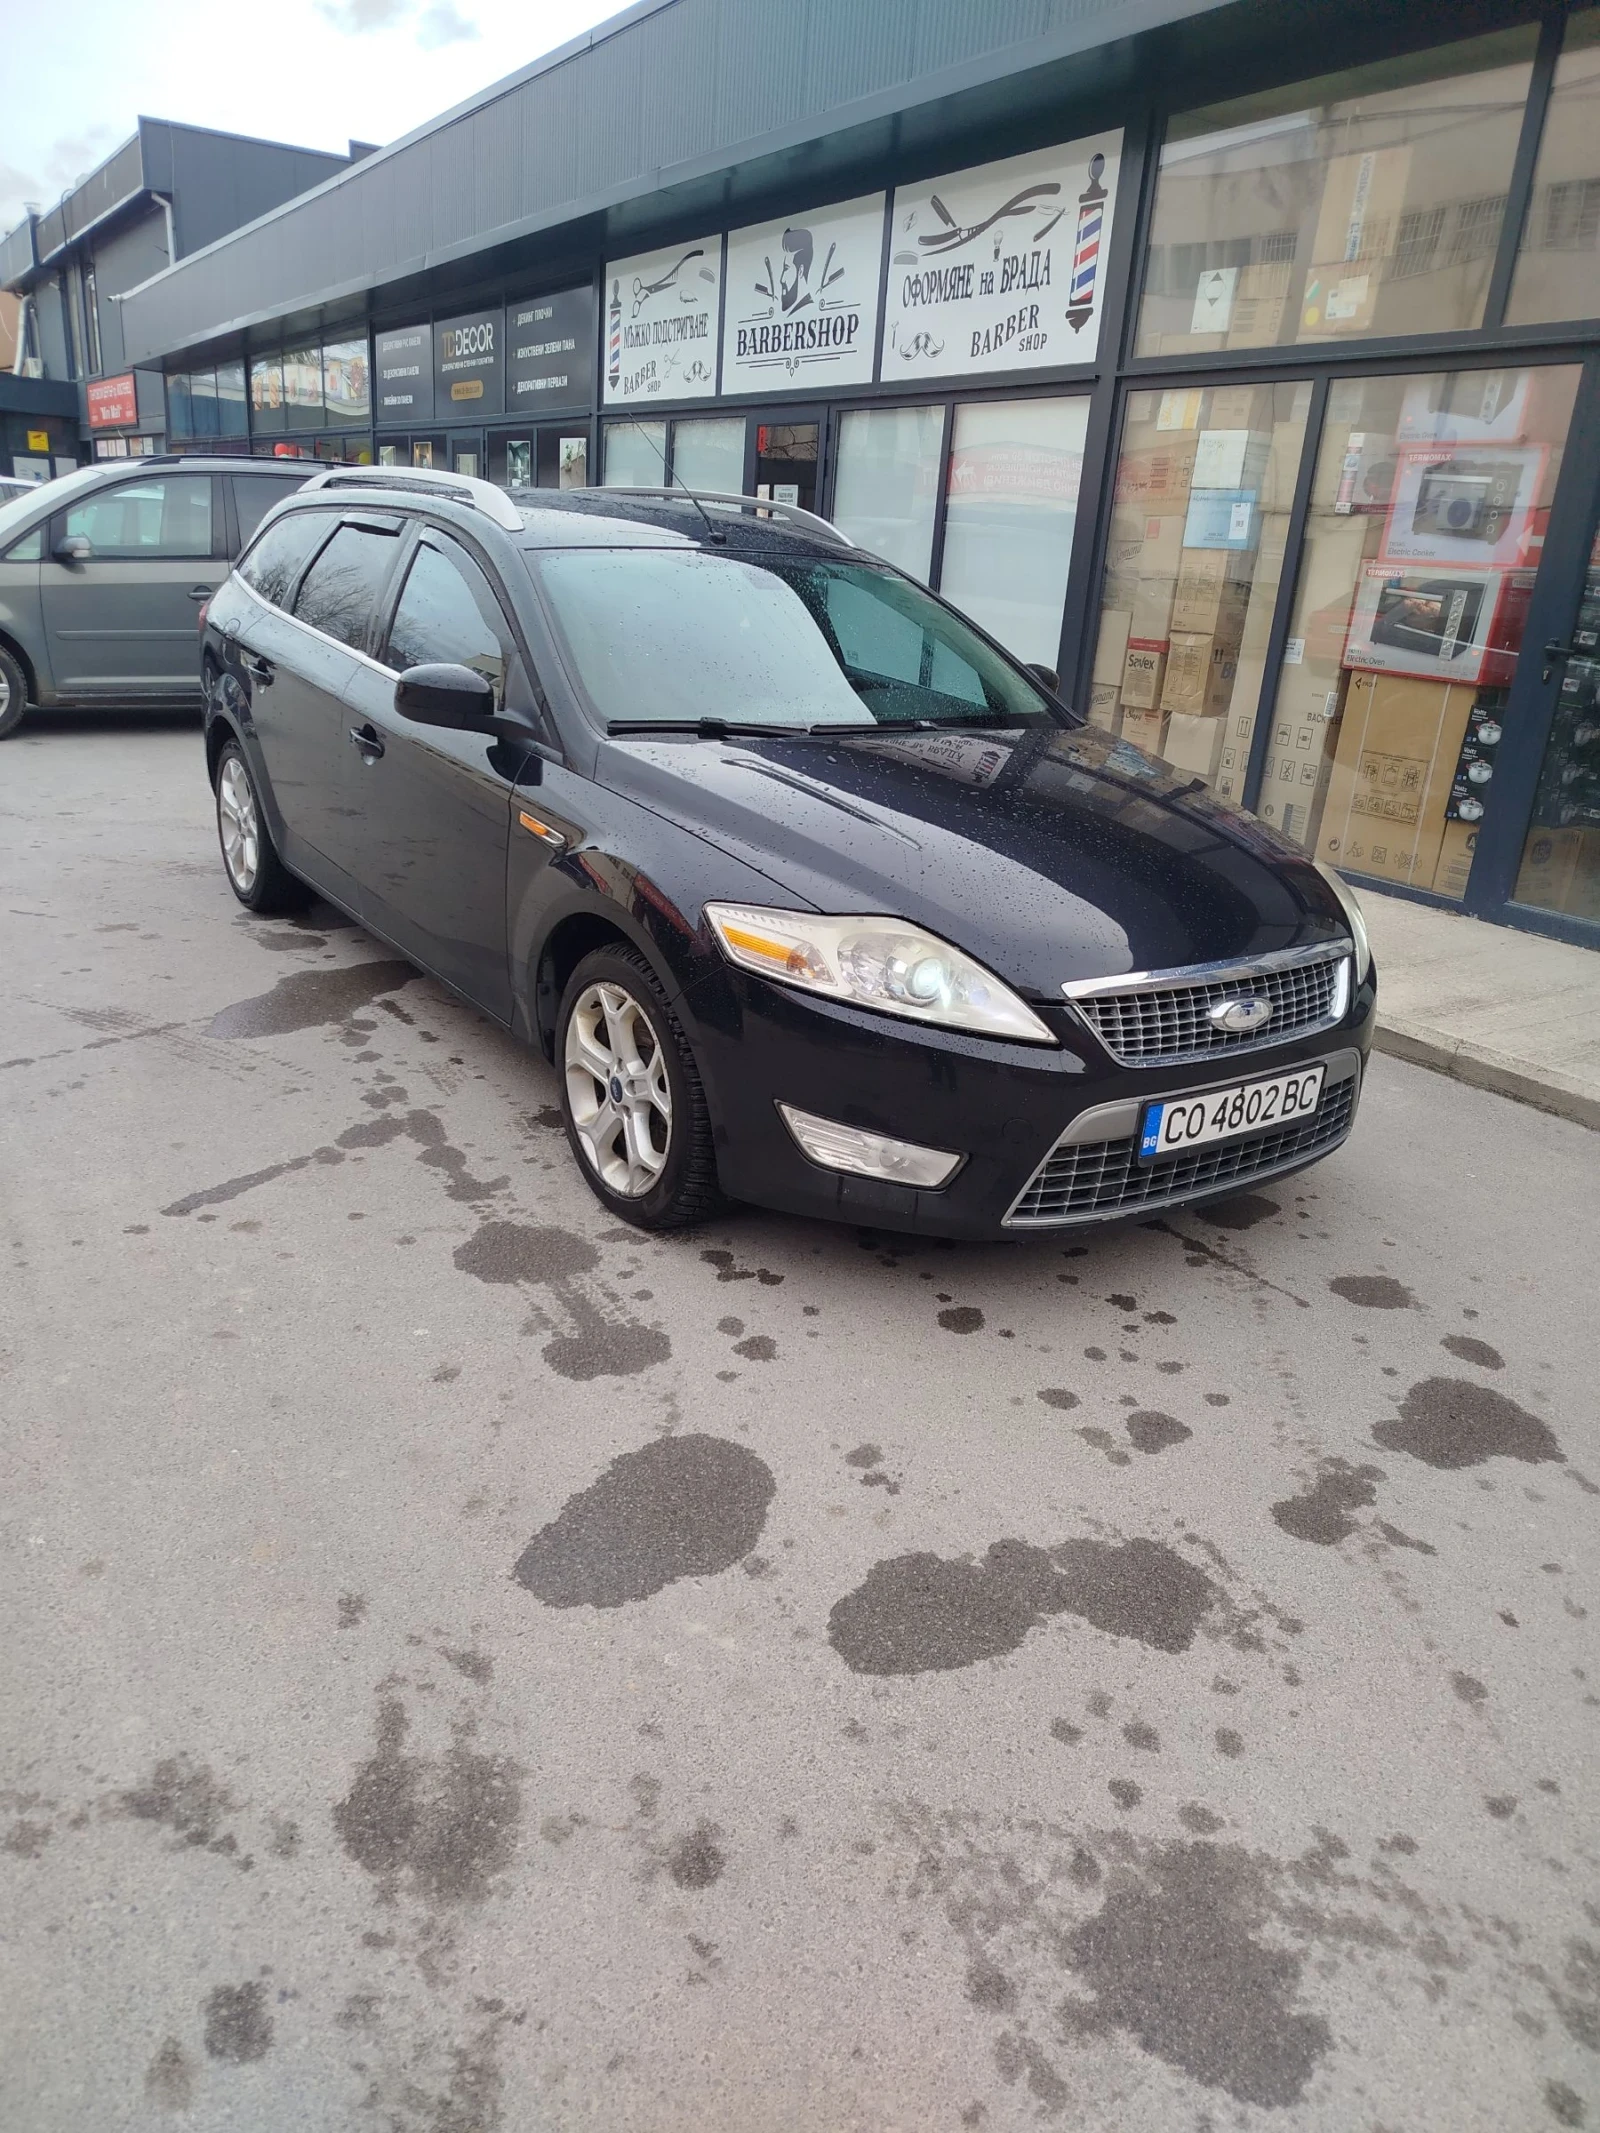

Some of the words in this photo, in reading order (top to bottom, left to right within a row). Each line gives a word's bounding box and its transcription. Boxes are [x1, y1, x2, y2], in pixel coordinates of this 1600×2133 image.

[903, 262, 975, 308] ОФОРМЯНЕ
[979, 271, 994, 295] на
[1000, 249, 1051, 295] БРАДА
[623, 322, 651, 349] МЪЖКО
[652, 313, 709, 347] ПОДСТРИГВАНЕ
[736, 313, 859, 356] BARBERSHOP
[970, 304, 1039, 357] BARBER
[545, 340, 561, 355] ЗЕЛЕНИ
[1018, 333, 1047, 352] SHOP
[624, 360, 657, 395] BARBER
[517, 378, 547, 394] ДЕКОРАТИВНИ
[647, 380, 661, 393] SHOP
[1408, 454, 1451, 462] TERMOMAX
[1412, 549, 1436, 557] Cooker
[1128, 654, 1155, 670] Savex
[1370, 657, 1385, 666] Oven
[1307, 712, 1326, 724] BACK
[1473, 708, 1487, 716] Voltz
[1464, 747, 1477, 755] Voltz
[1454, 784, 1468, 793] Voltz
[1165, 1103, 1206, 1144] CO
[1211, 1084, 1280, 1132] 4802
[1281, 1074, 1317, 1116] BC
[1142, 1135, 1157, 1149] BG
